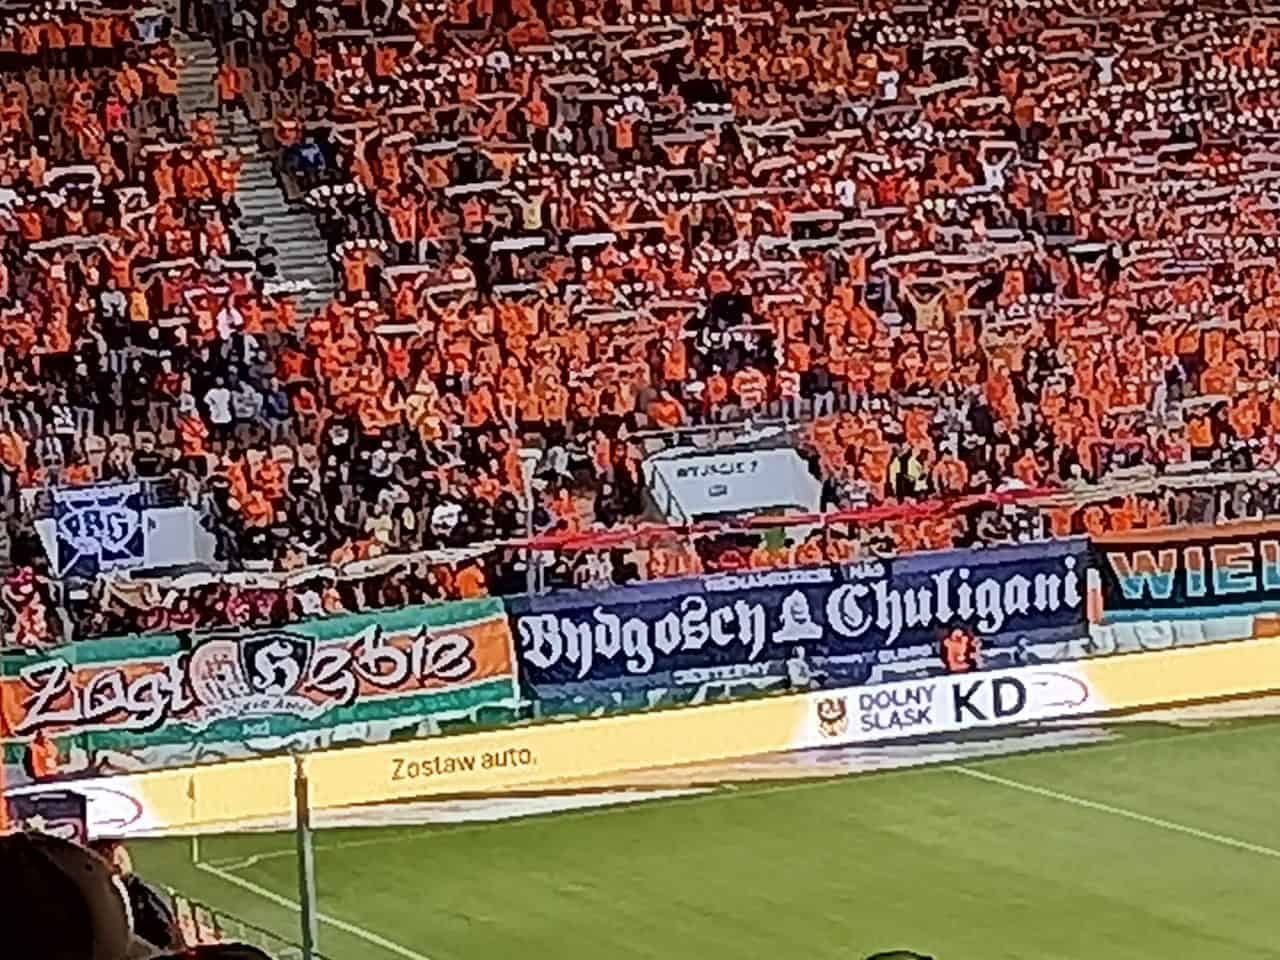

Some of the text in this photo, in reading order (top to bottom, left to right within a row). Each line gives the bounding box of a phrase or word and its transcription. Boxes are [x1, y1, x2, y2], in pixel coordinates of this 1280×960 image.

[825, 556, 1082, 646] Chuligani
[858, 684, 936, 711] DOLNY
[952, 676, 1027, 723] KD
[391, 753, 475, 781] Zostaw
